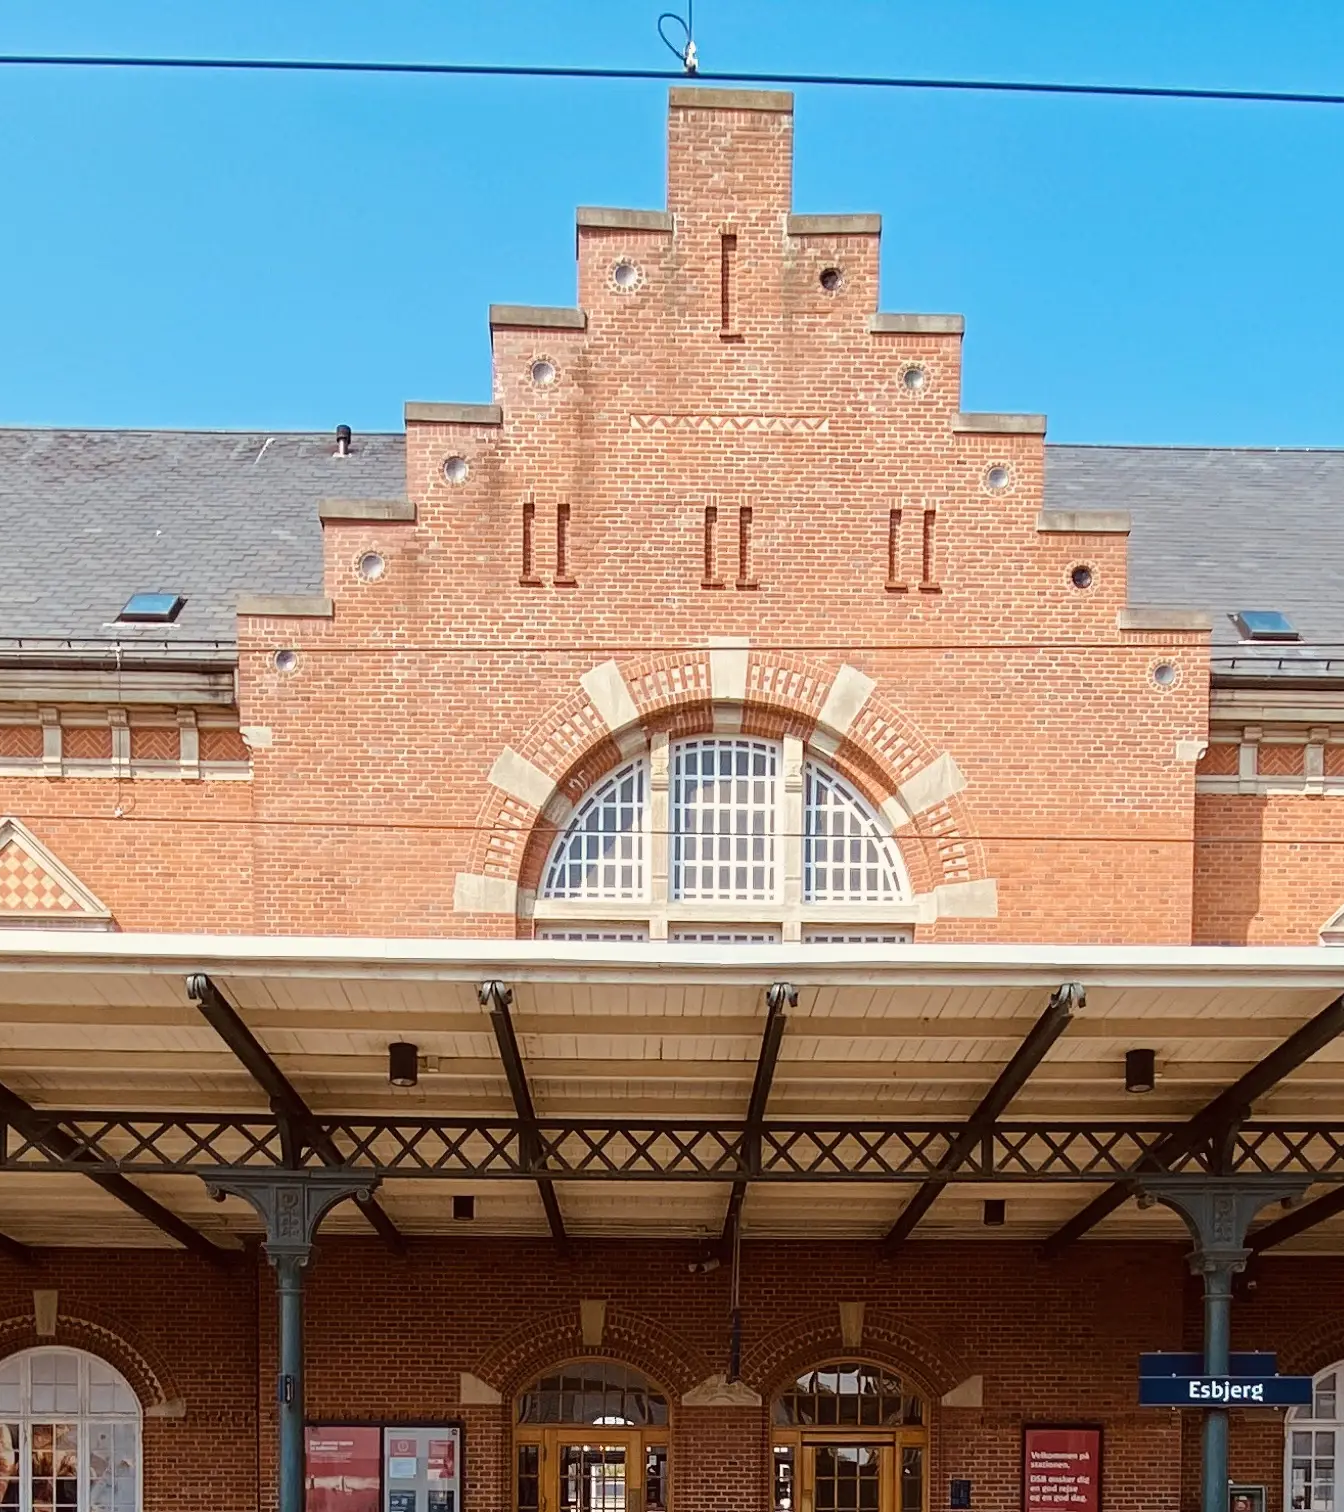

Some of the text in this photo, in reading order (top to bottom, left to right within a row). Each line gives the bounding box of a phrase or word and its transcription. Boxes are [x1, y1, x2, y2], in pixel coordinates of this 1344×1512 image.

[1188, 1380, 1264, 1402] Esbjerg
[1030, 1451, 1090, 1460] Velkommen på
[1077, 1475, 1090, 1485] dig
[1042, 1484, 1057, 1493] god
[1058, 1485, 1078, 1494] rejse
[1029, 1494, 1040, 1502] og
[1041, 1494, 1052, 1502] en
[1053, 1493, 1069, 1502] god
